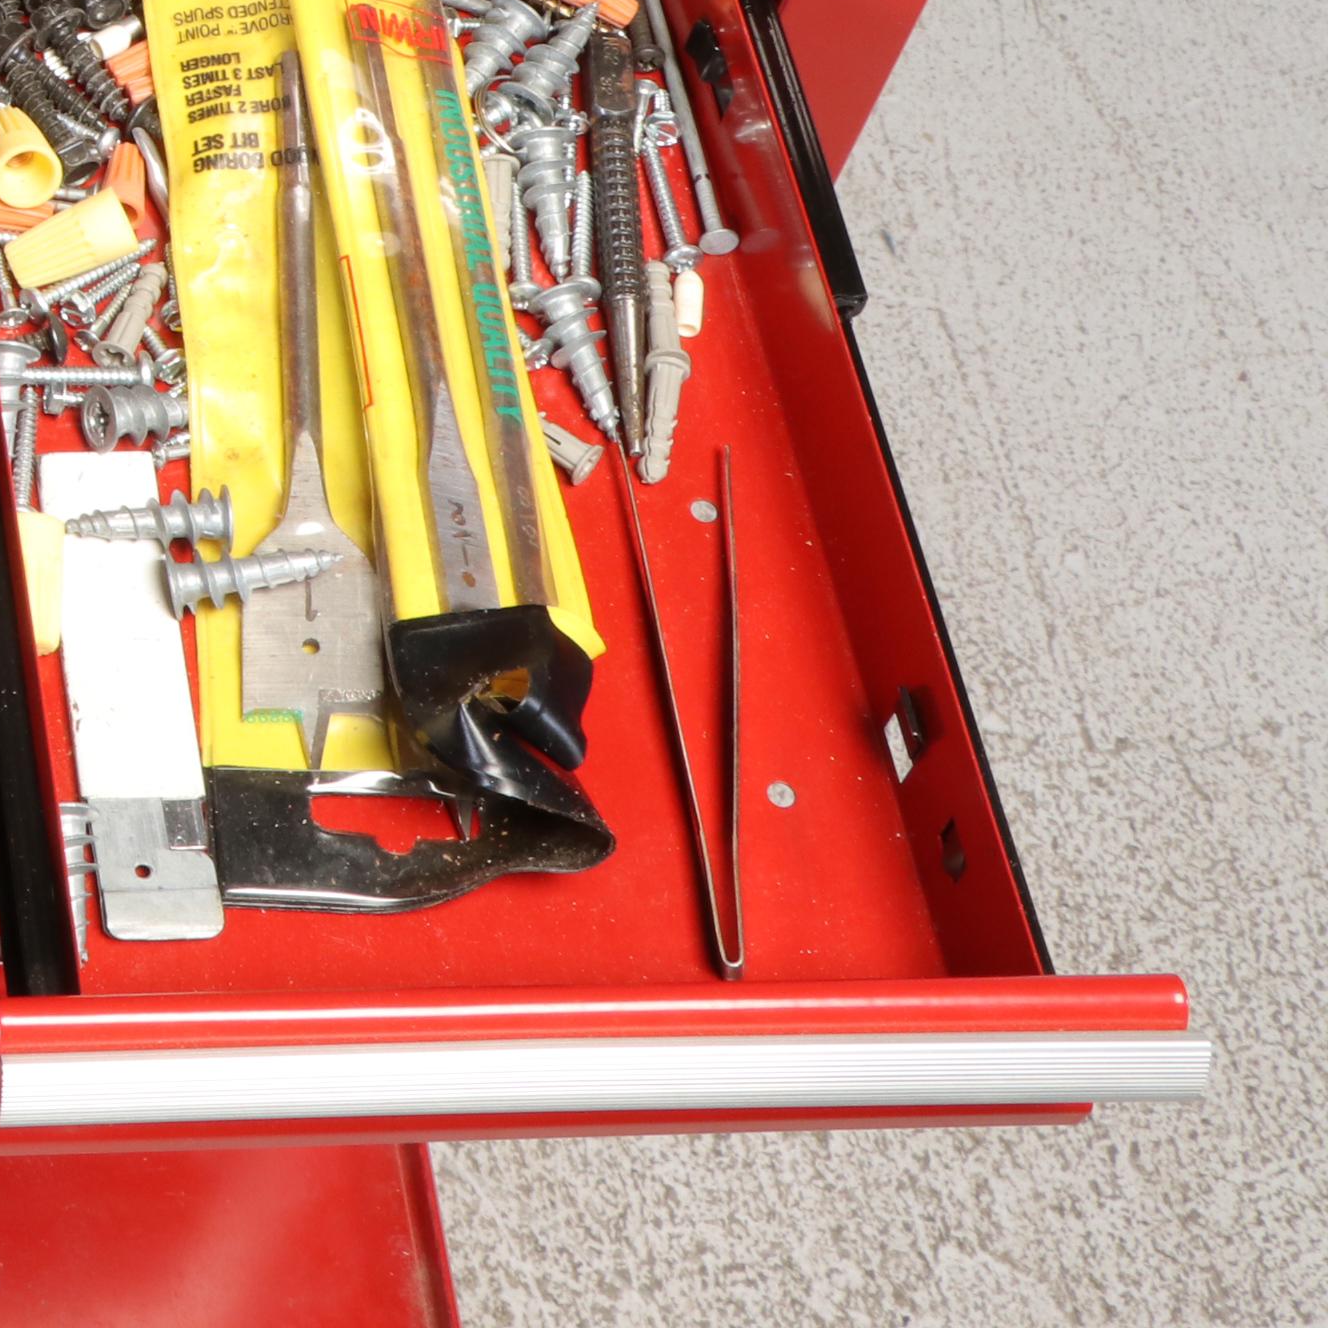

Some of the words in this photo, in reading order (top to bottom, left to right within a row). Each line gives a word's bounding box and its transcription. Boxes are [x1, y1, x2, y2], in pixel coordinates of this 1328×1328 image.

[172, 6, 222, 25] SPURS
[226, 13, 291, 34] ROOVE™
[176, 24, 219, 43] POINT
[180, 52, 240, 71] LONGER
[246, 61, 282, 81] LAST
[182, 68, 225, 88] TIMES
[232, 67, 241, 80] 3
[184, 84, 240, 106] FASTER
[187, 101, 231, 123] TIMES
[237, 100, 246, 113] 2
[191, 134, 223, 155] SET
[231, 132, 258, 148] BIT
[192, 154, 262, 172] BORING
[433, 89, 494, 270] INDUSTRIAL
[471, 283, 523, 423] QUALITY
